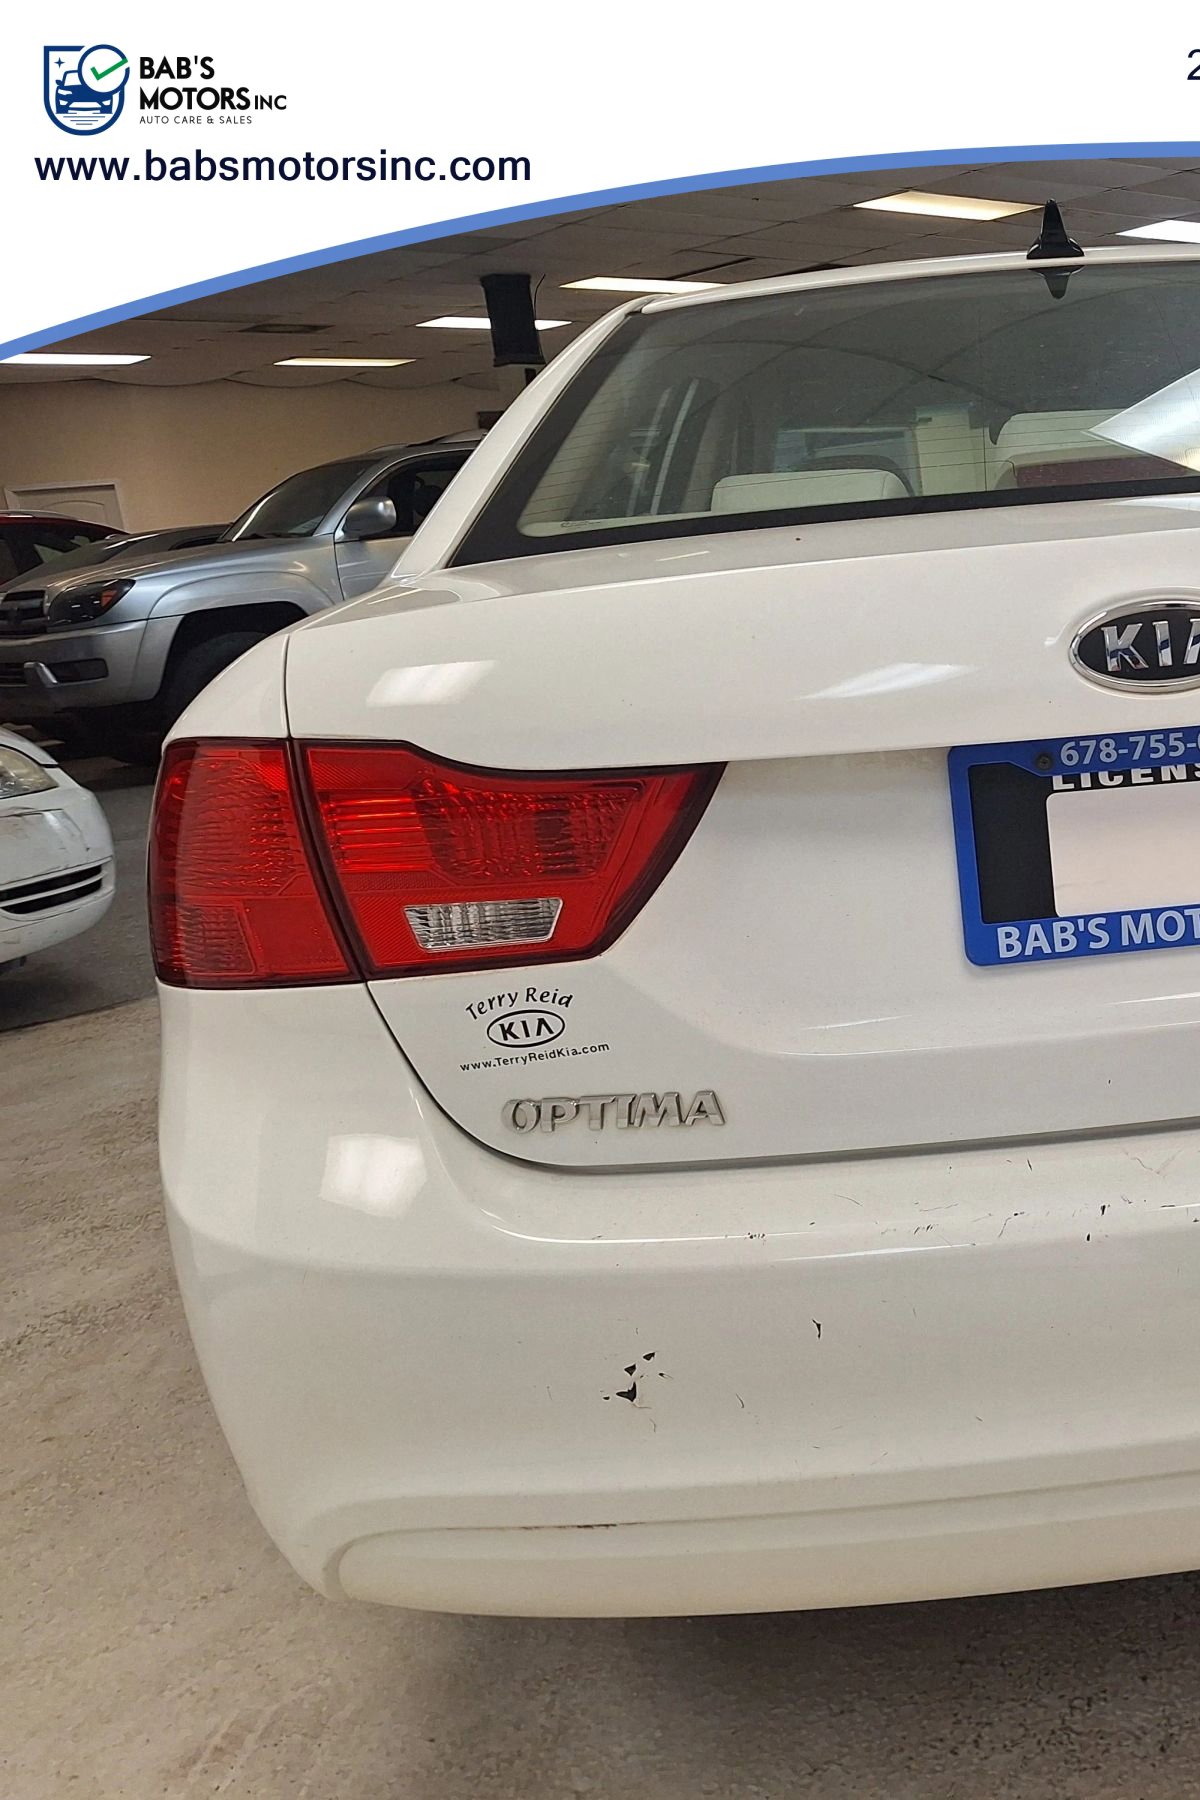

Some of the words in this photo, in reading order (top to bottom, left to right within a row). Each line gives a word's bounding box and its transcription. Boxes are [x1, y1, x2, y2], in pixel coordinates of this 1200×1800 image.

[996, 917, 1110, 958] BAB'S
[465, 991, 519, 1021] Terry
[525, 987, 574, 1008] Reid
[498, 1017, 554, 1041] KIA
[459, 1042, 610, 1072] www.TerryReidKia.com
[502, 1089, 727, 1134] OPTIMA
